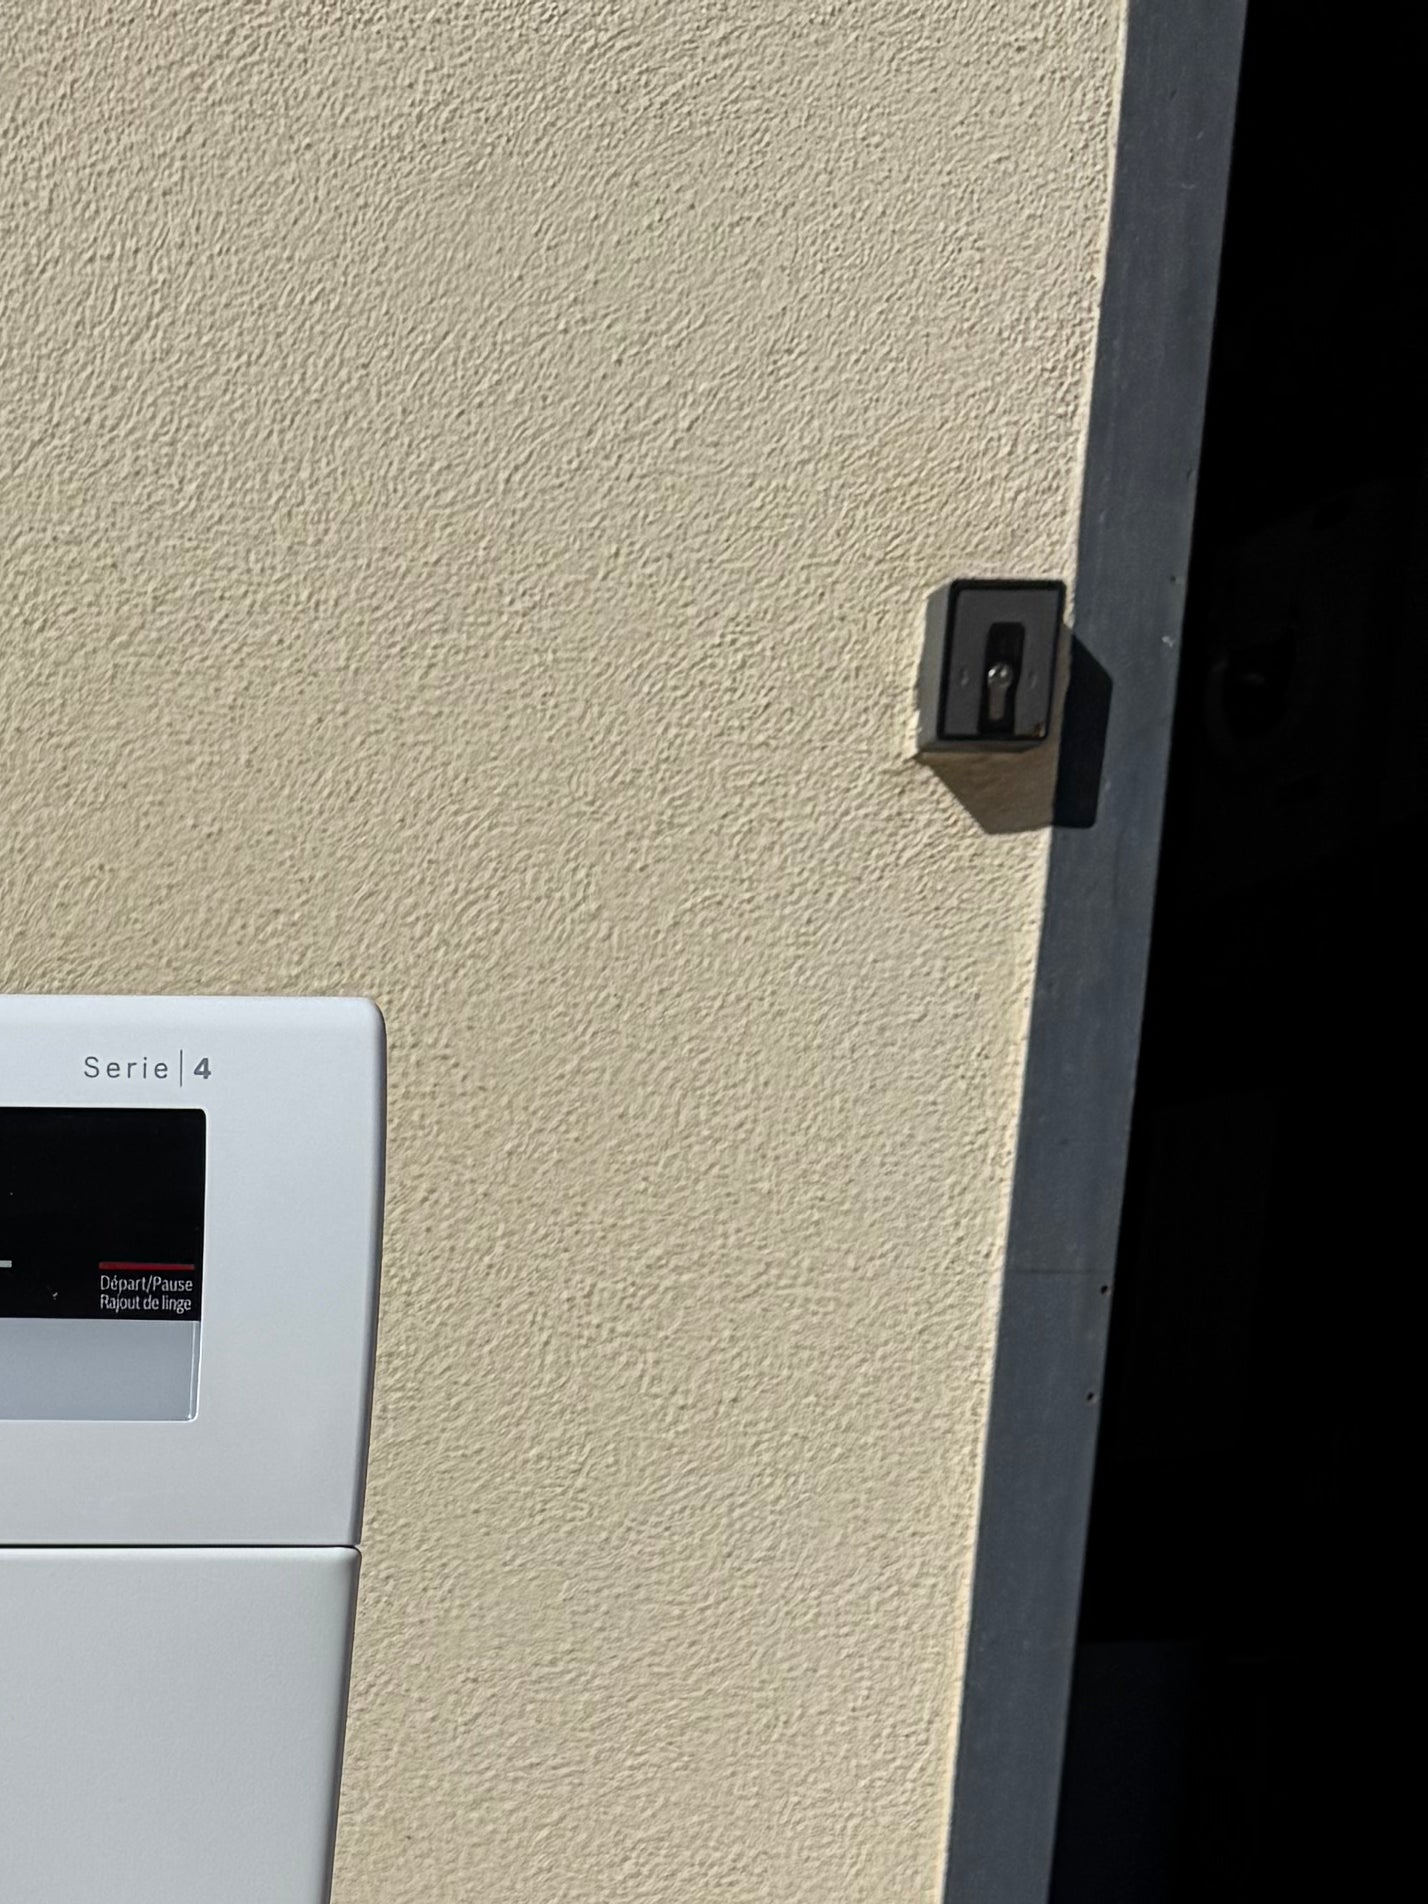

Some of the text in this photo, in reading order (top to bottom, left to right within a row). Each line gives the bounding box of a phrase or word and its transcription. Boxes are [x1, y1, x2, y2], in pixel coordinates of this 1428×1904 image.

[83, 1056, 213, 1080] Serie 4
[99, 1273, 194, 1296] Départ/Pause
[99, 1293, 193, 1315] Rajout de linge
